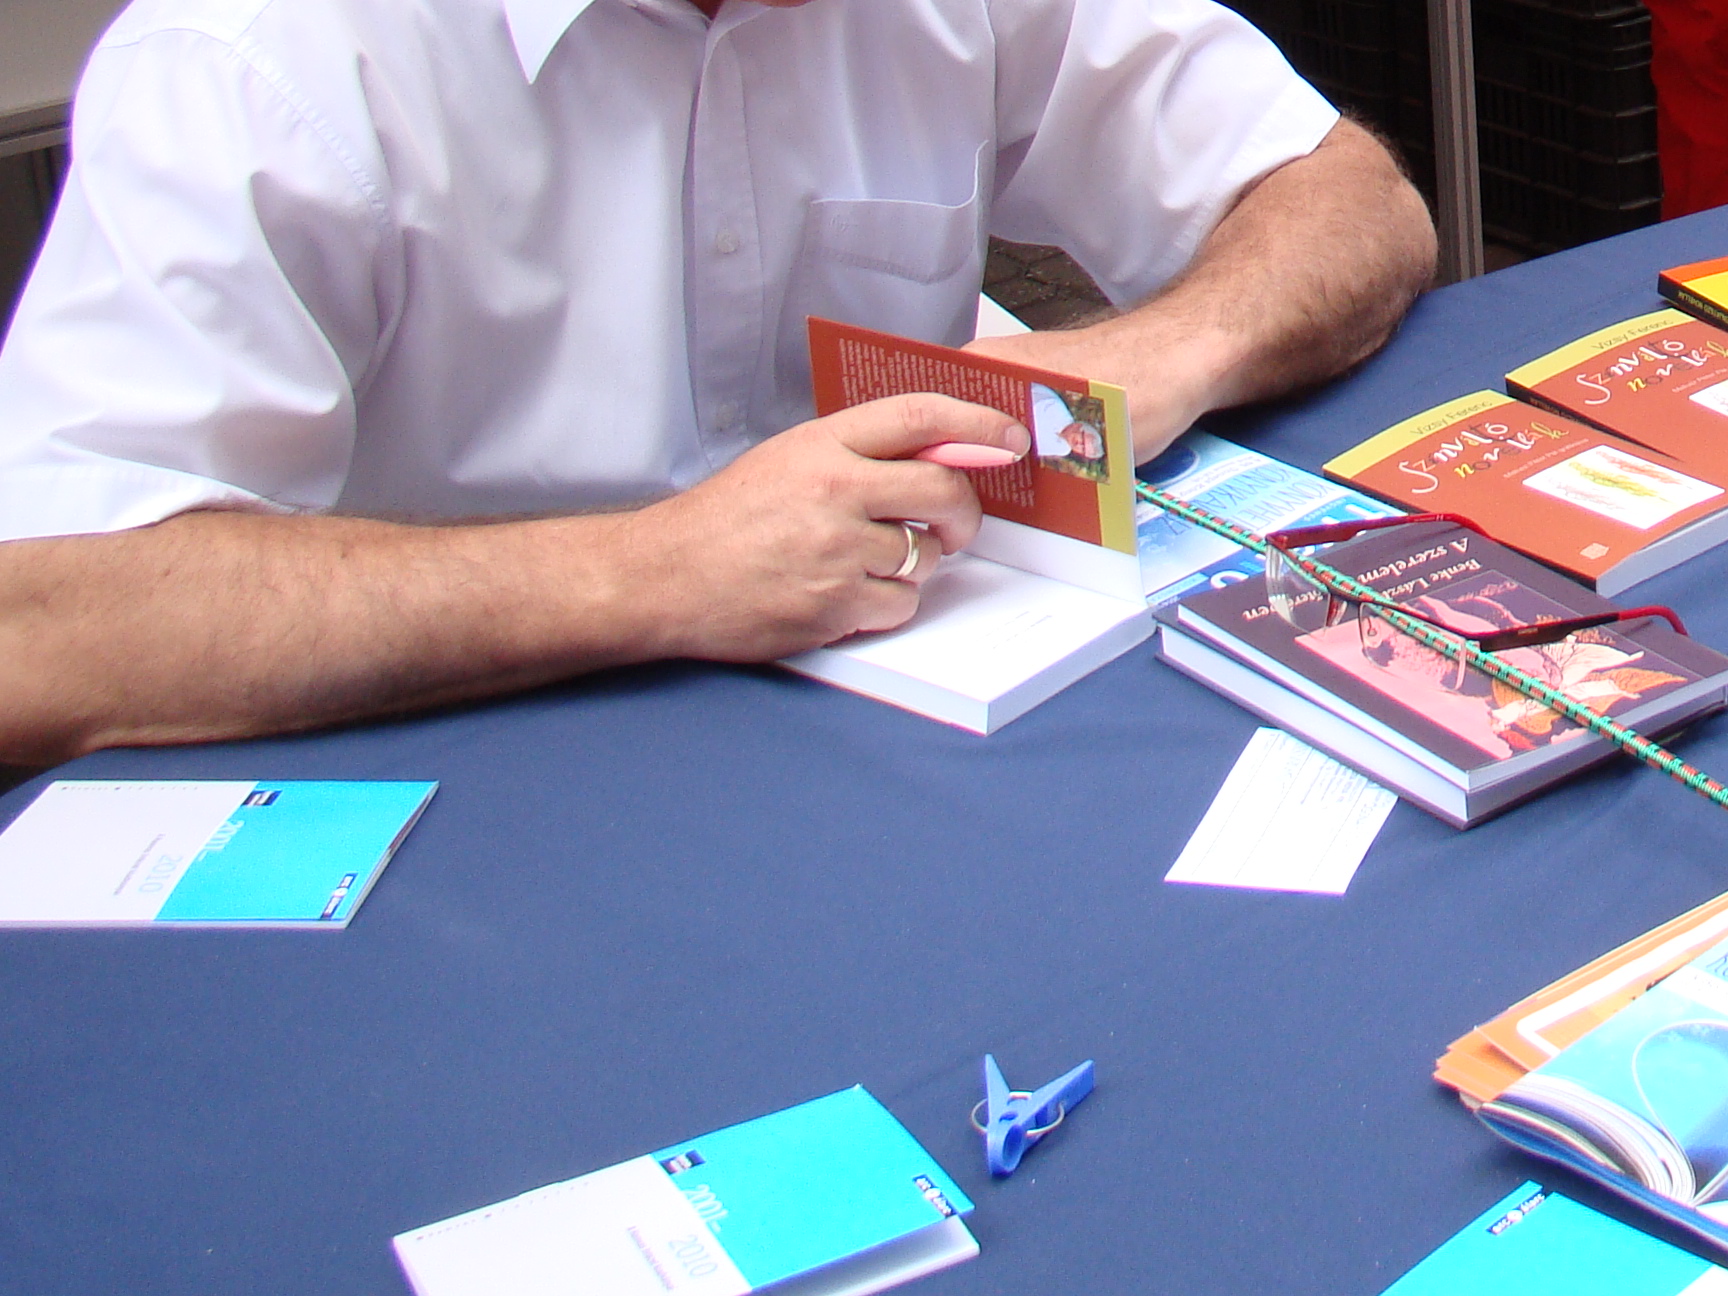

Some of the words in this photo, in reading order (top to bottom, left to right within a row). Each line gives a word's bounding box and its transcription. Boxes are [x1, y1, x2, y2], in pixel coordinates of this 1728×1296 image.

[1454, 421, 1569, 479] novellák
[1449, 537, 1470, 554] A
[1357, 547, 1449, 585] szerelem
[1430, 558, 1483, 583] Benke
[1381, 575, 1430, 601] Lászl
